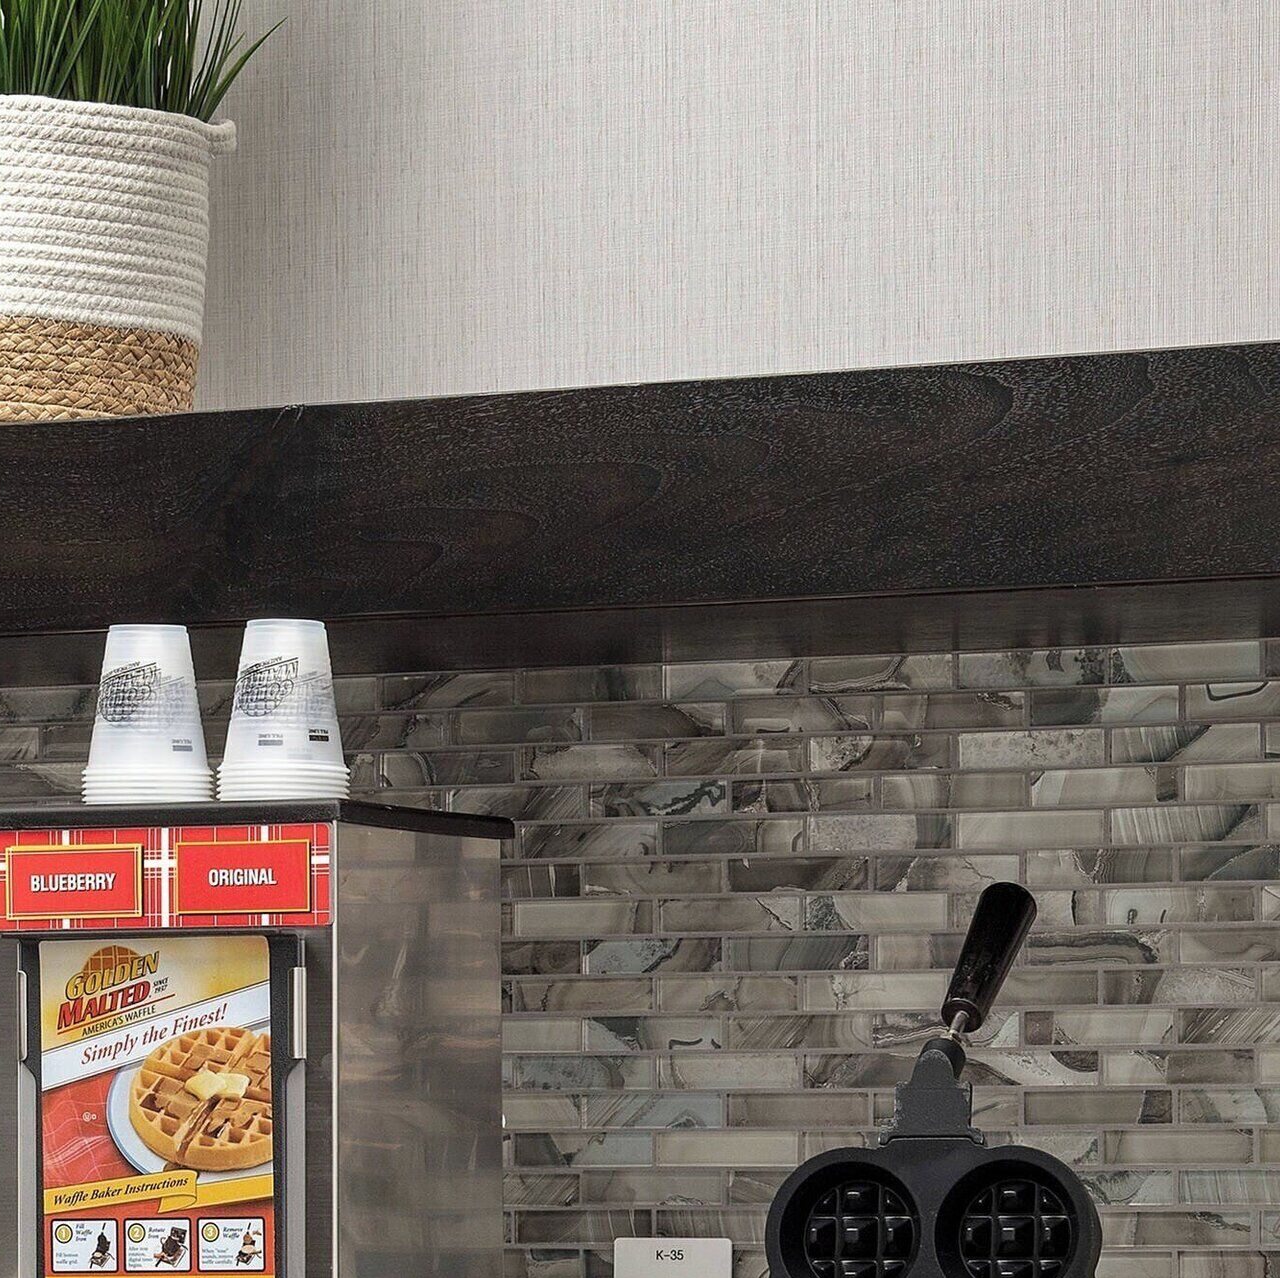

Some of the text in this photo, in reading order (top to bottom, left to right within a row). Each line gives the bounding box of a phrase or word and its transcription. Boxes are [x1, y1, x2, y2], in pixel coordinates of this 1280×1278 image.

[30, 872, 117, 893] BLUEBERRY
[208, 868, 277, 887] ORIGINAL
[65, 950, 160, 1001] GOLDEN
[153, 976, 169, 987] SINCE
[57, 980, 152, 1030] MALTED
[81, 1004, 156, 1037] AMERICA'S WAFFLE
[80, 1003, 228, 1065] Simply the Finest!
[53, 1175, 189, 1206] Waffle Baker Instructions
[656, 1250, 684, 1261] K-35
